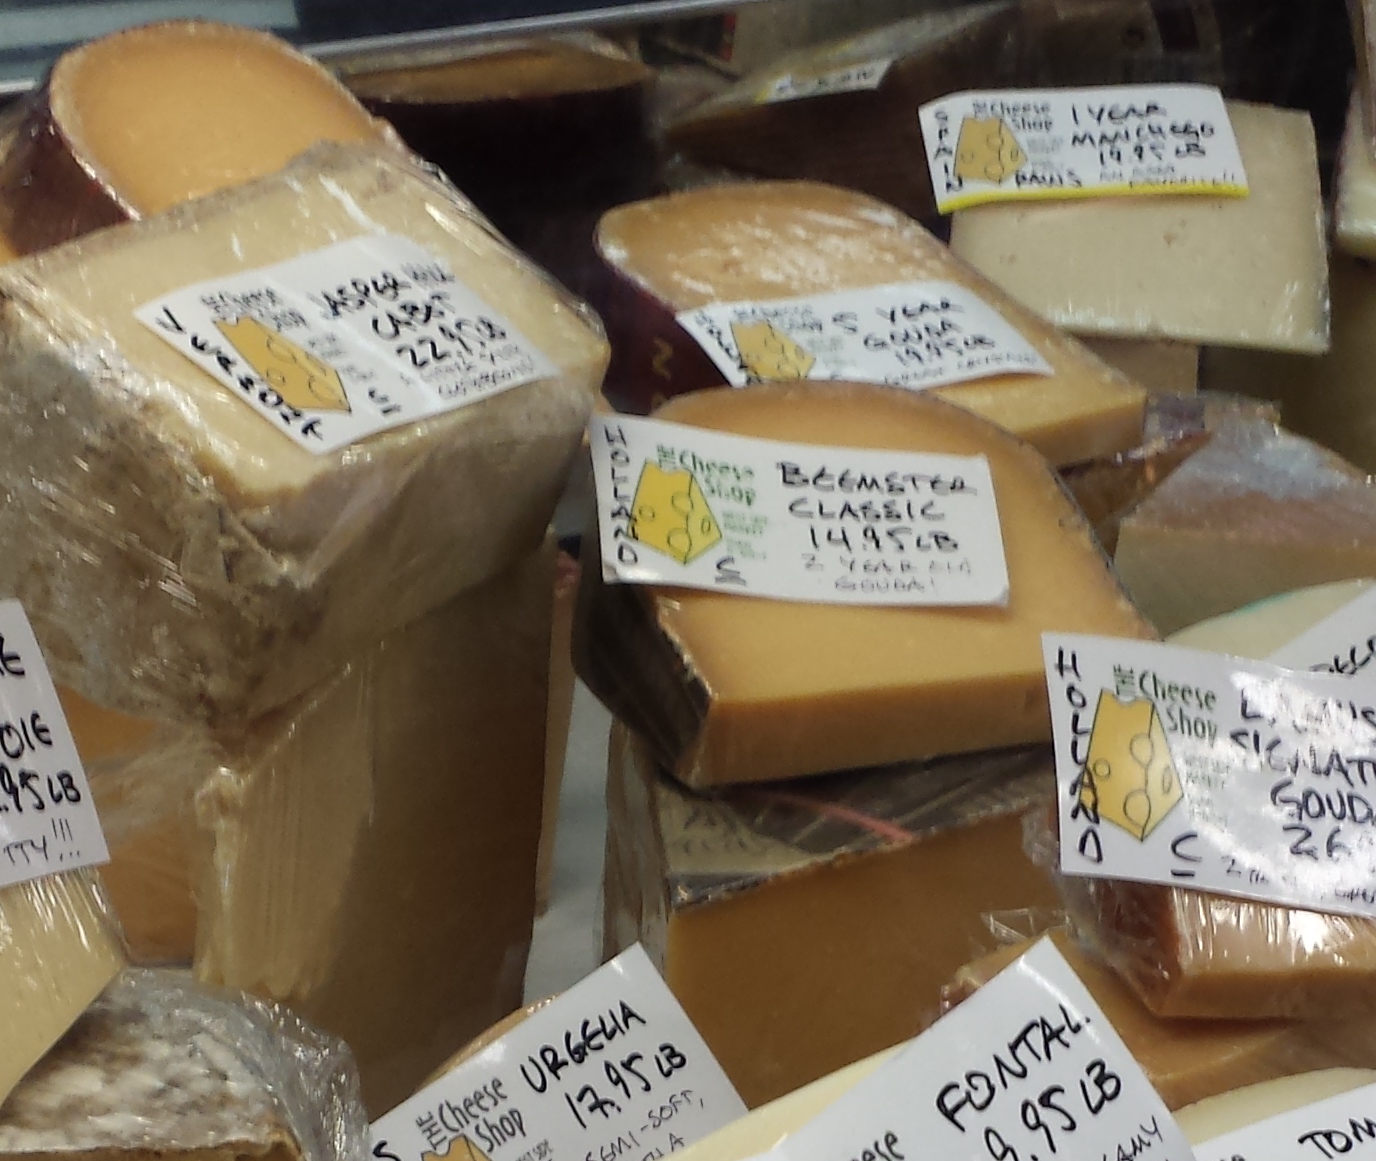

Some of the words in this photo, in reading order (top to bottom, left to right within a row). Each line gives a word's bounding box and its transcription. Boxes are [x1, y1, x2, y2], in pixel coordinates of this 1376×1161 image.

[678, 449, 755, 480] Cheese
[777, 460, 978, 496] BEEMSTER
[787, 498, 946, 522] CLASSIC
[1139, 668, 1217, 711] Cheese
[1055, 645, 1104, 864] HOLLAND
[519, 1000, 647, 1095] URGELIA
[416, 1109, 447, 1150] THE
[437, 1076, 509, 1135] Cheese
[475, 1108, 526, 1154] Shop
